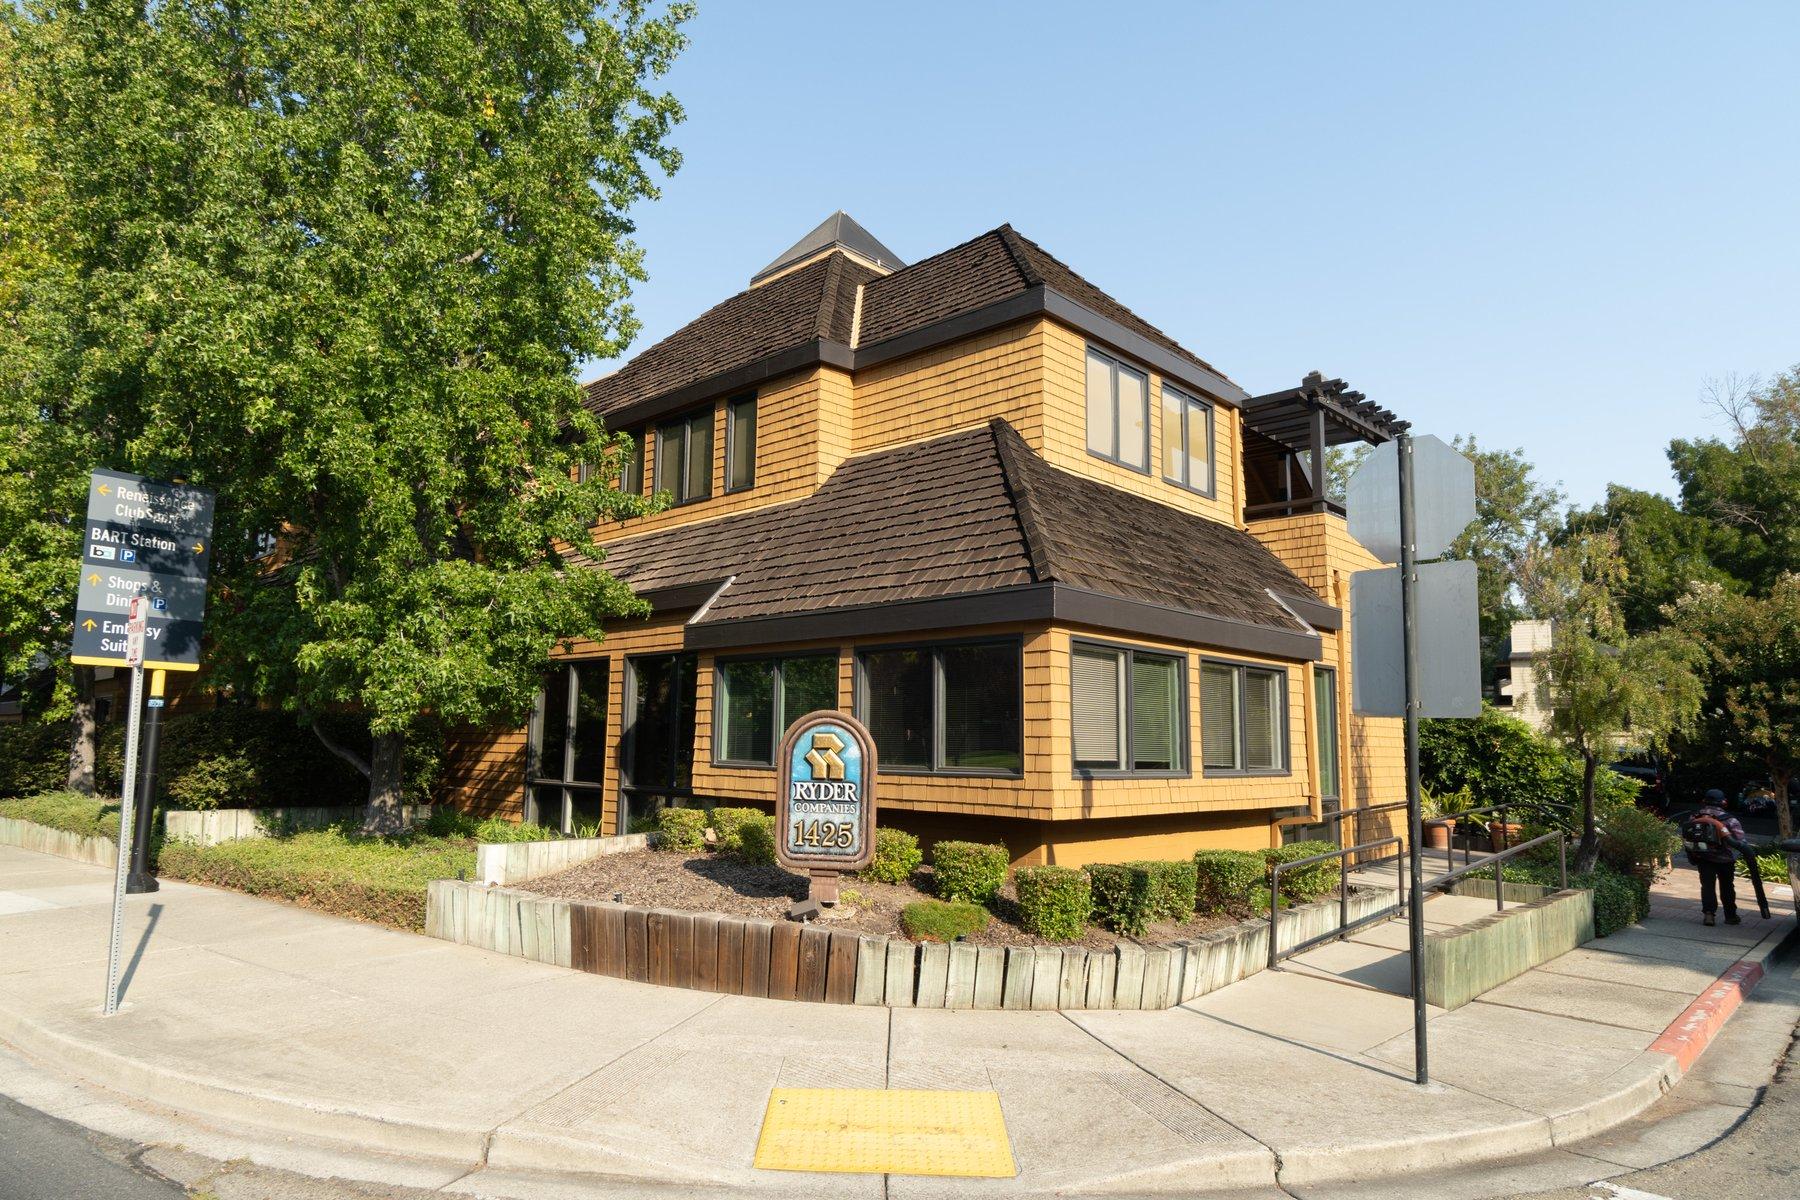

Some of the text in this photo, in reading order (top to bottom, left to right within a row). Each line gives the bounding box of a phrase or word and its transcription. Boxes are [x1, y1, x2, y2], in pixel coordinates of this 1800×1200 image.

[117, 486, 196, 511] Renaissance
[91, 527, 176, 551] BART Station
[108, 575, 163, 594] Shops &
[106, 593, 131, 607] Dini
[102, 621, 162, 639] Emsy
[100, 638, 128, 652] Suit
[793, 782, 858, 802] RYDER
[794, 802, 856, 814] COMPANIES
[793, 820, 854, 848] 1425
